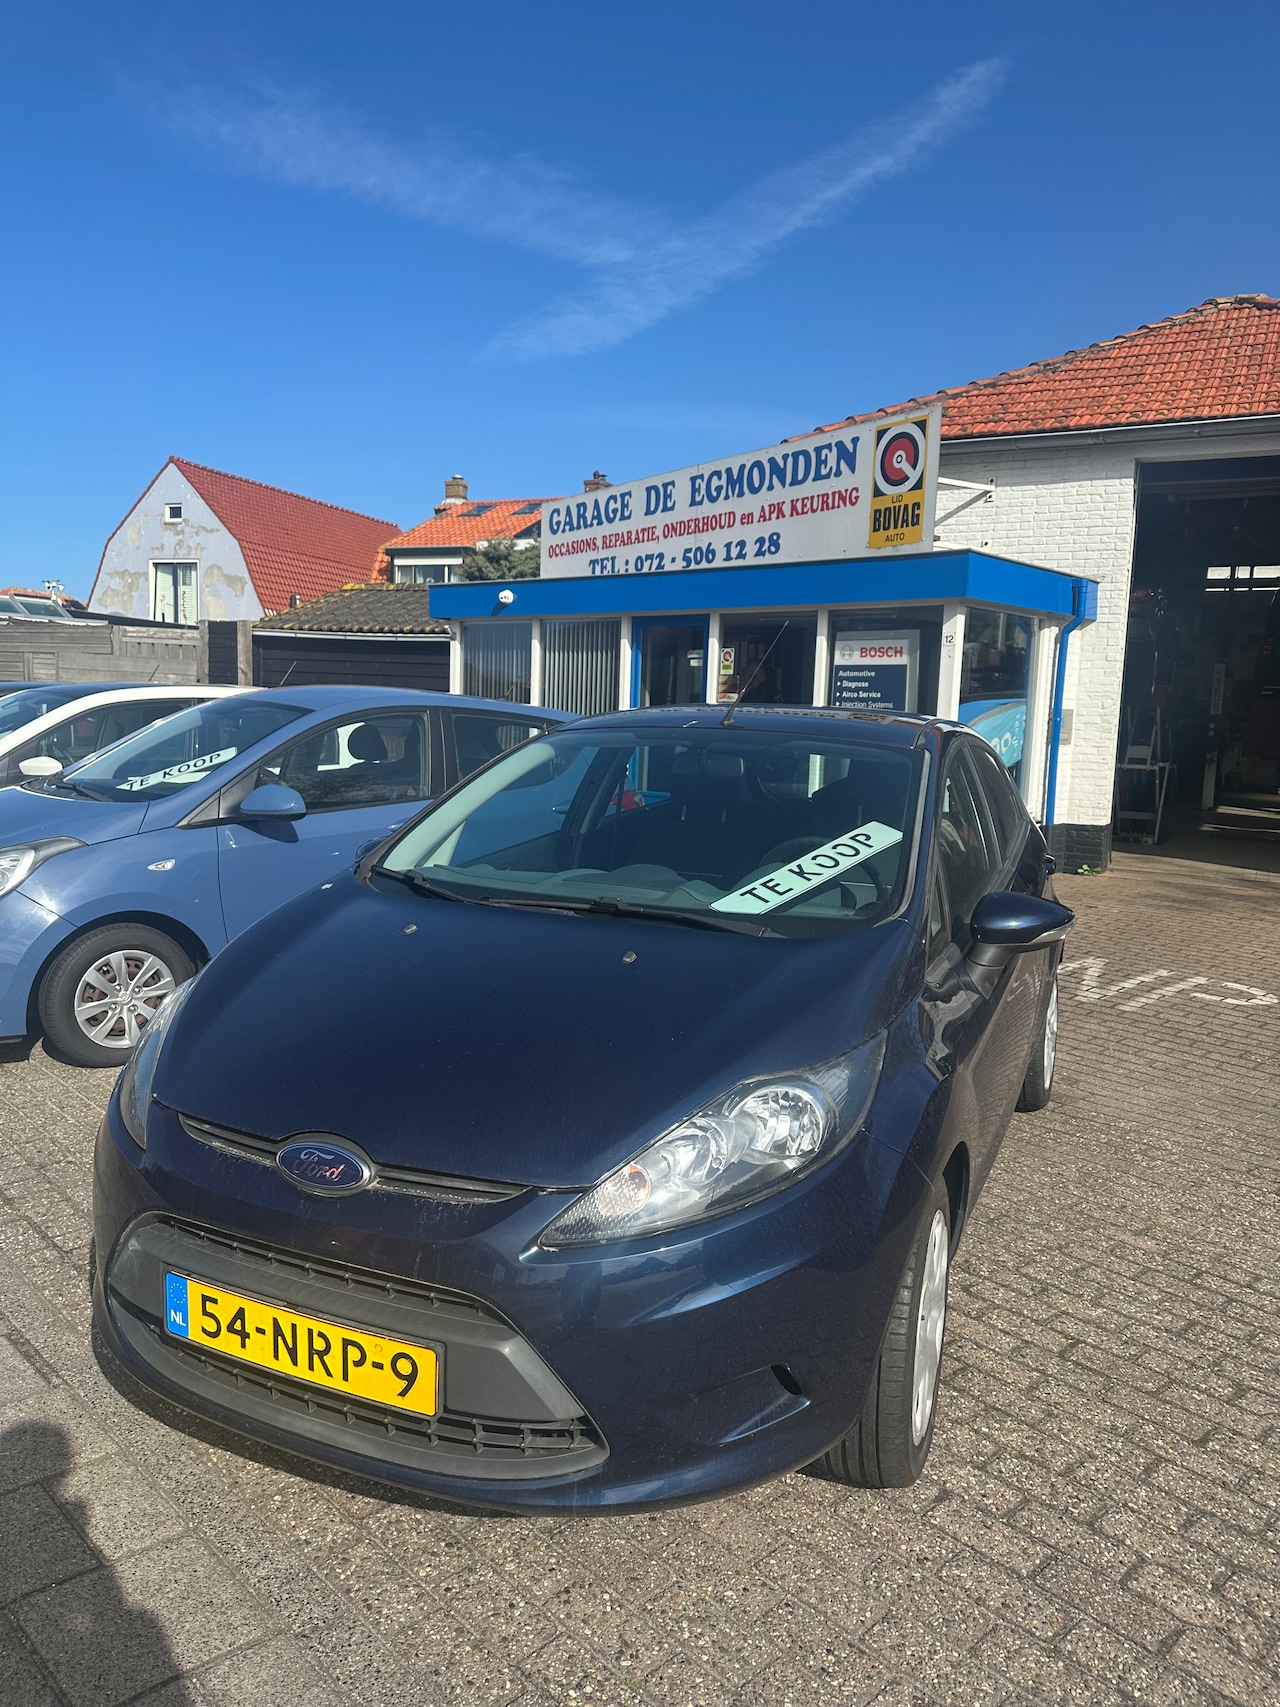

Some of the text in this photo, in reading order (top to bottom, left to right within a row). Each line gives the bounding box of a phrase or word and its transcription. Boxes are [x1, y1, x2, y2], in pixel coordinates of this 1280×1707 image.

[548, 436, 861, 535] GARAGE DE EGMONDEN
[891, 494, 904, 504] LID
[548, 487, 860, 559] OCCASIONS, REPARATIE, ONDERHOUD en APK KEURING
[872, 502, 921, 532] BOVAG
[884, 532, 905, 543] AUTO
[634, 552, 666, 573] 072
[681, 542, 717, 569] 506
[723, 539, 747, 562] 12
[753, 532, 781, 558] 28
[944, 634, 954, 643] 12
[859, 646, 904, 658] BOSCH
[838, 669, 876, 677] Automotive
[842, 680, 869, 688] Diagnose
[841, 690, 882, 698] Airco Service
[867, 701, 894, 709] Systems
[126, 753, 221, 791] TE KOOP
[739, 832, 875, 904] TE KOOP
[292, 1148, 346, 1182] Ford
[170, 1309, 187, 1327] NL
[200, 1293, 419, 1398] 54-NRP-9
